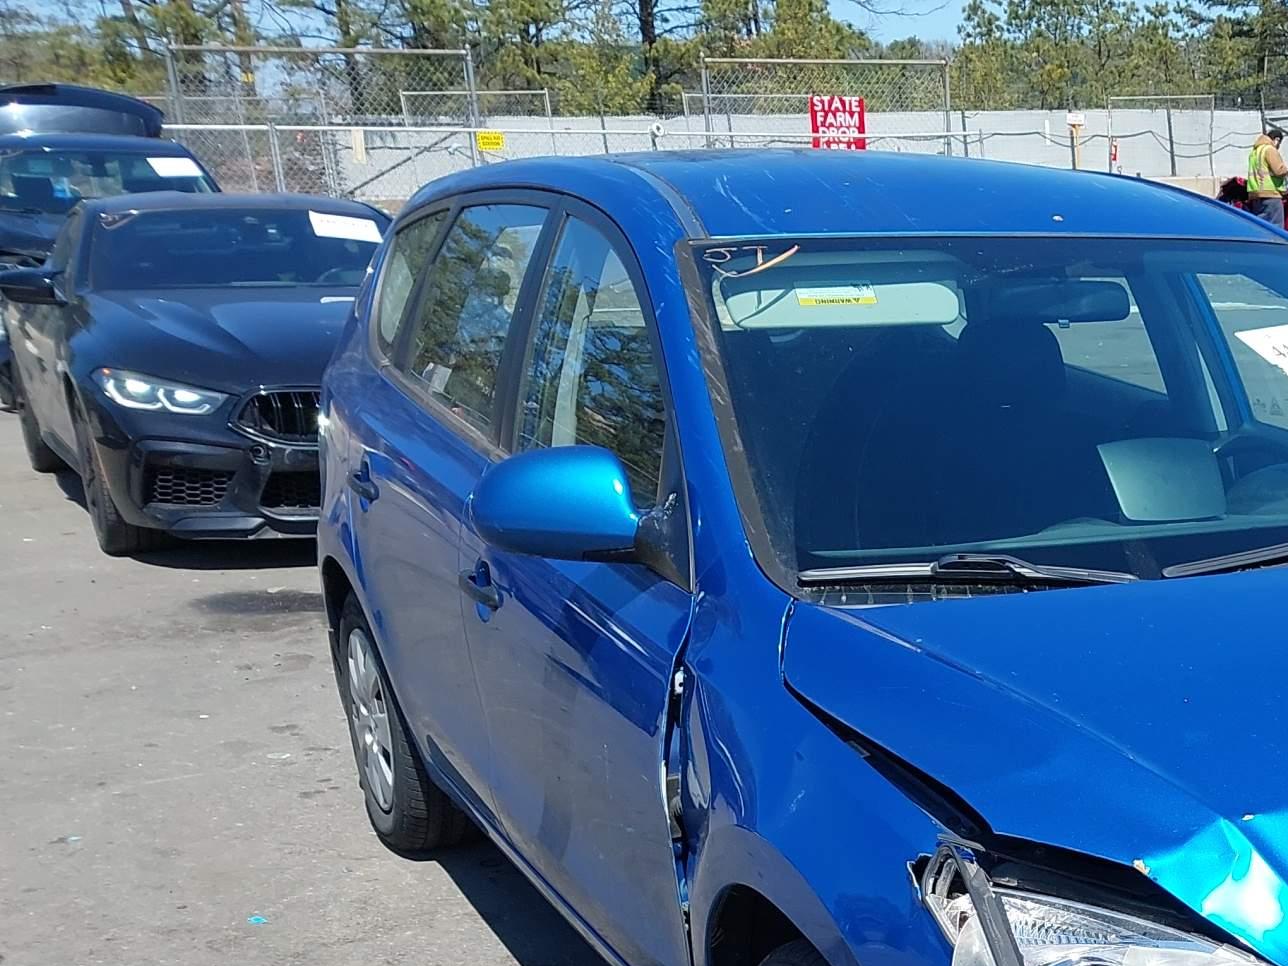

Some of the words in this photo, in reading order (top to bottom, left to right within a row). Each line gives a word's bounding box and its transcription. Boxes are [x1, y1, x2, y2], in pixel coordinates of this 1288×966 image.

[812, 96, 860, 111] STATE
[816, 112, 859, 127] FARM
[818, 127, 858, 142] DROP
